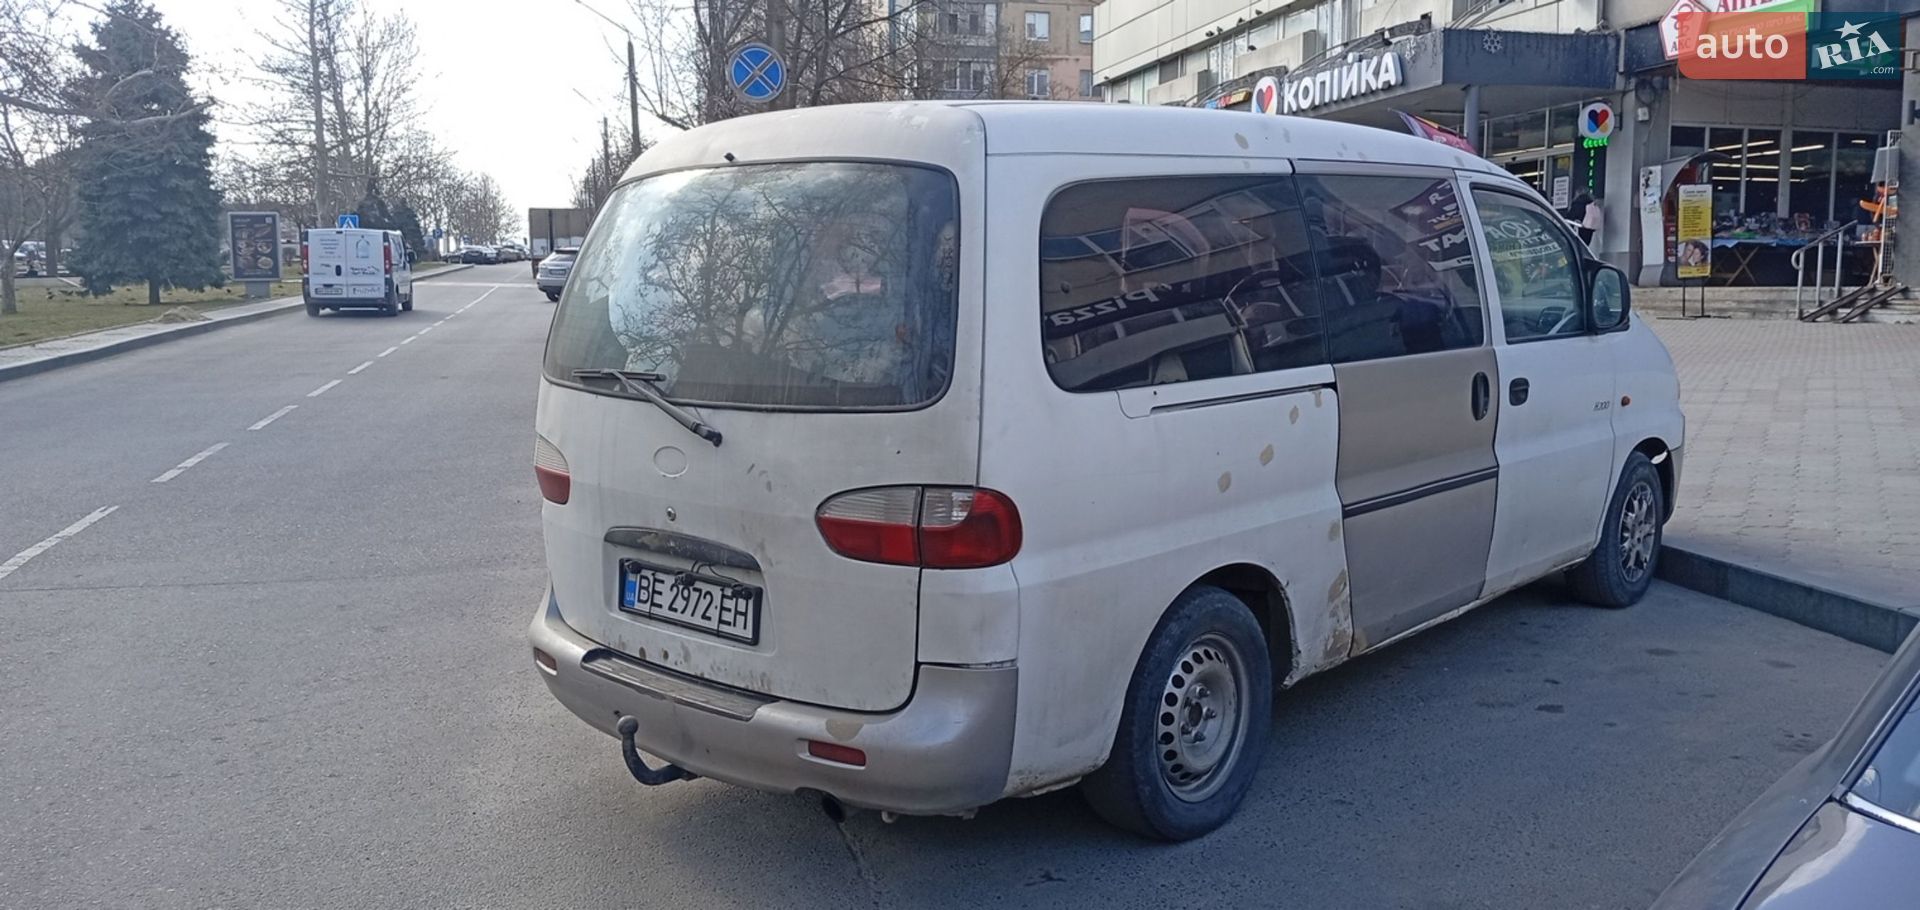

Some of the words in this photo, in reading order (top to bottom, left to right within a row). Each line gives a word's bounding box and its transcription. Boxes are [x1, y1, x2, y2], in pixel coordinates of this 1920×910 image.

[1283, 52, 1398, 114] КОПІЙКА
[637, 575, 665, 609] BE
[668, 584, 714, 622] 2972
